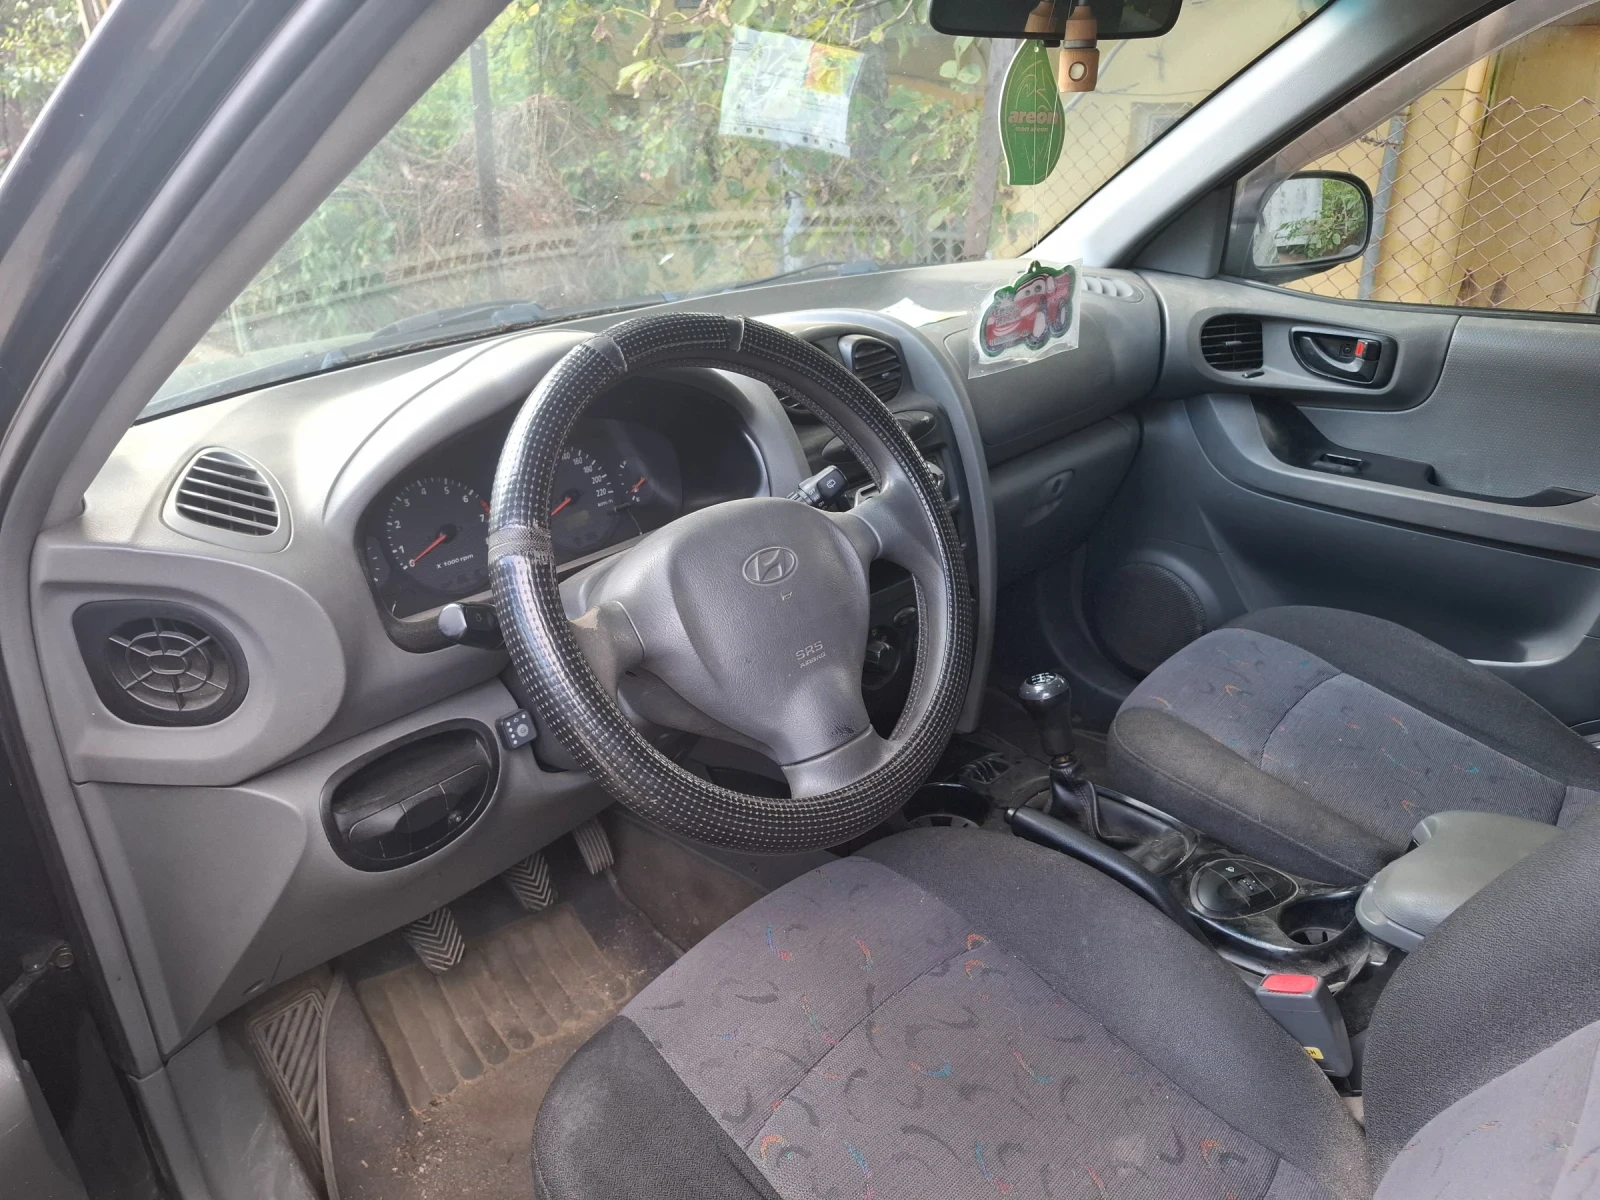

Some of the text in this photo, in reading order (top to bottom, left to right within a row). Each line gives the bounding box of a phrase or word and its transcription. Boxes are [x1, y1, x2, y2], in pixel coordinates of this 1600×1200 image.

[1008, 110, 1059, 125] areon
[573, 457, 583, 466] 160
[583, 465, 593, 474] 180
[591, 475, 602, 485] 200
[444, 486, 450, 495] 5
[596, 488, 607, 497] 220
[404, 498, 411, 507] 3
[462, 495, 469, 503] 6
[479, 514, 485, 522] 7
[394, 520, 401, 529] 2
[398, 545, 405, 554] 1
[443, 557, 460, 567] 1000
[460, 553, 474, 563] rpm
[795, 640, 824, 661] SRS
[800, 651, 826, 669] AIRBAG
